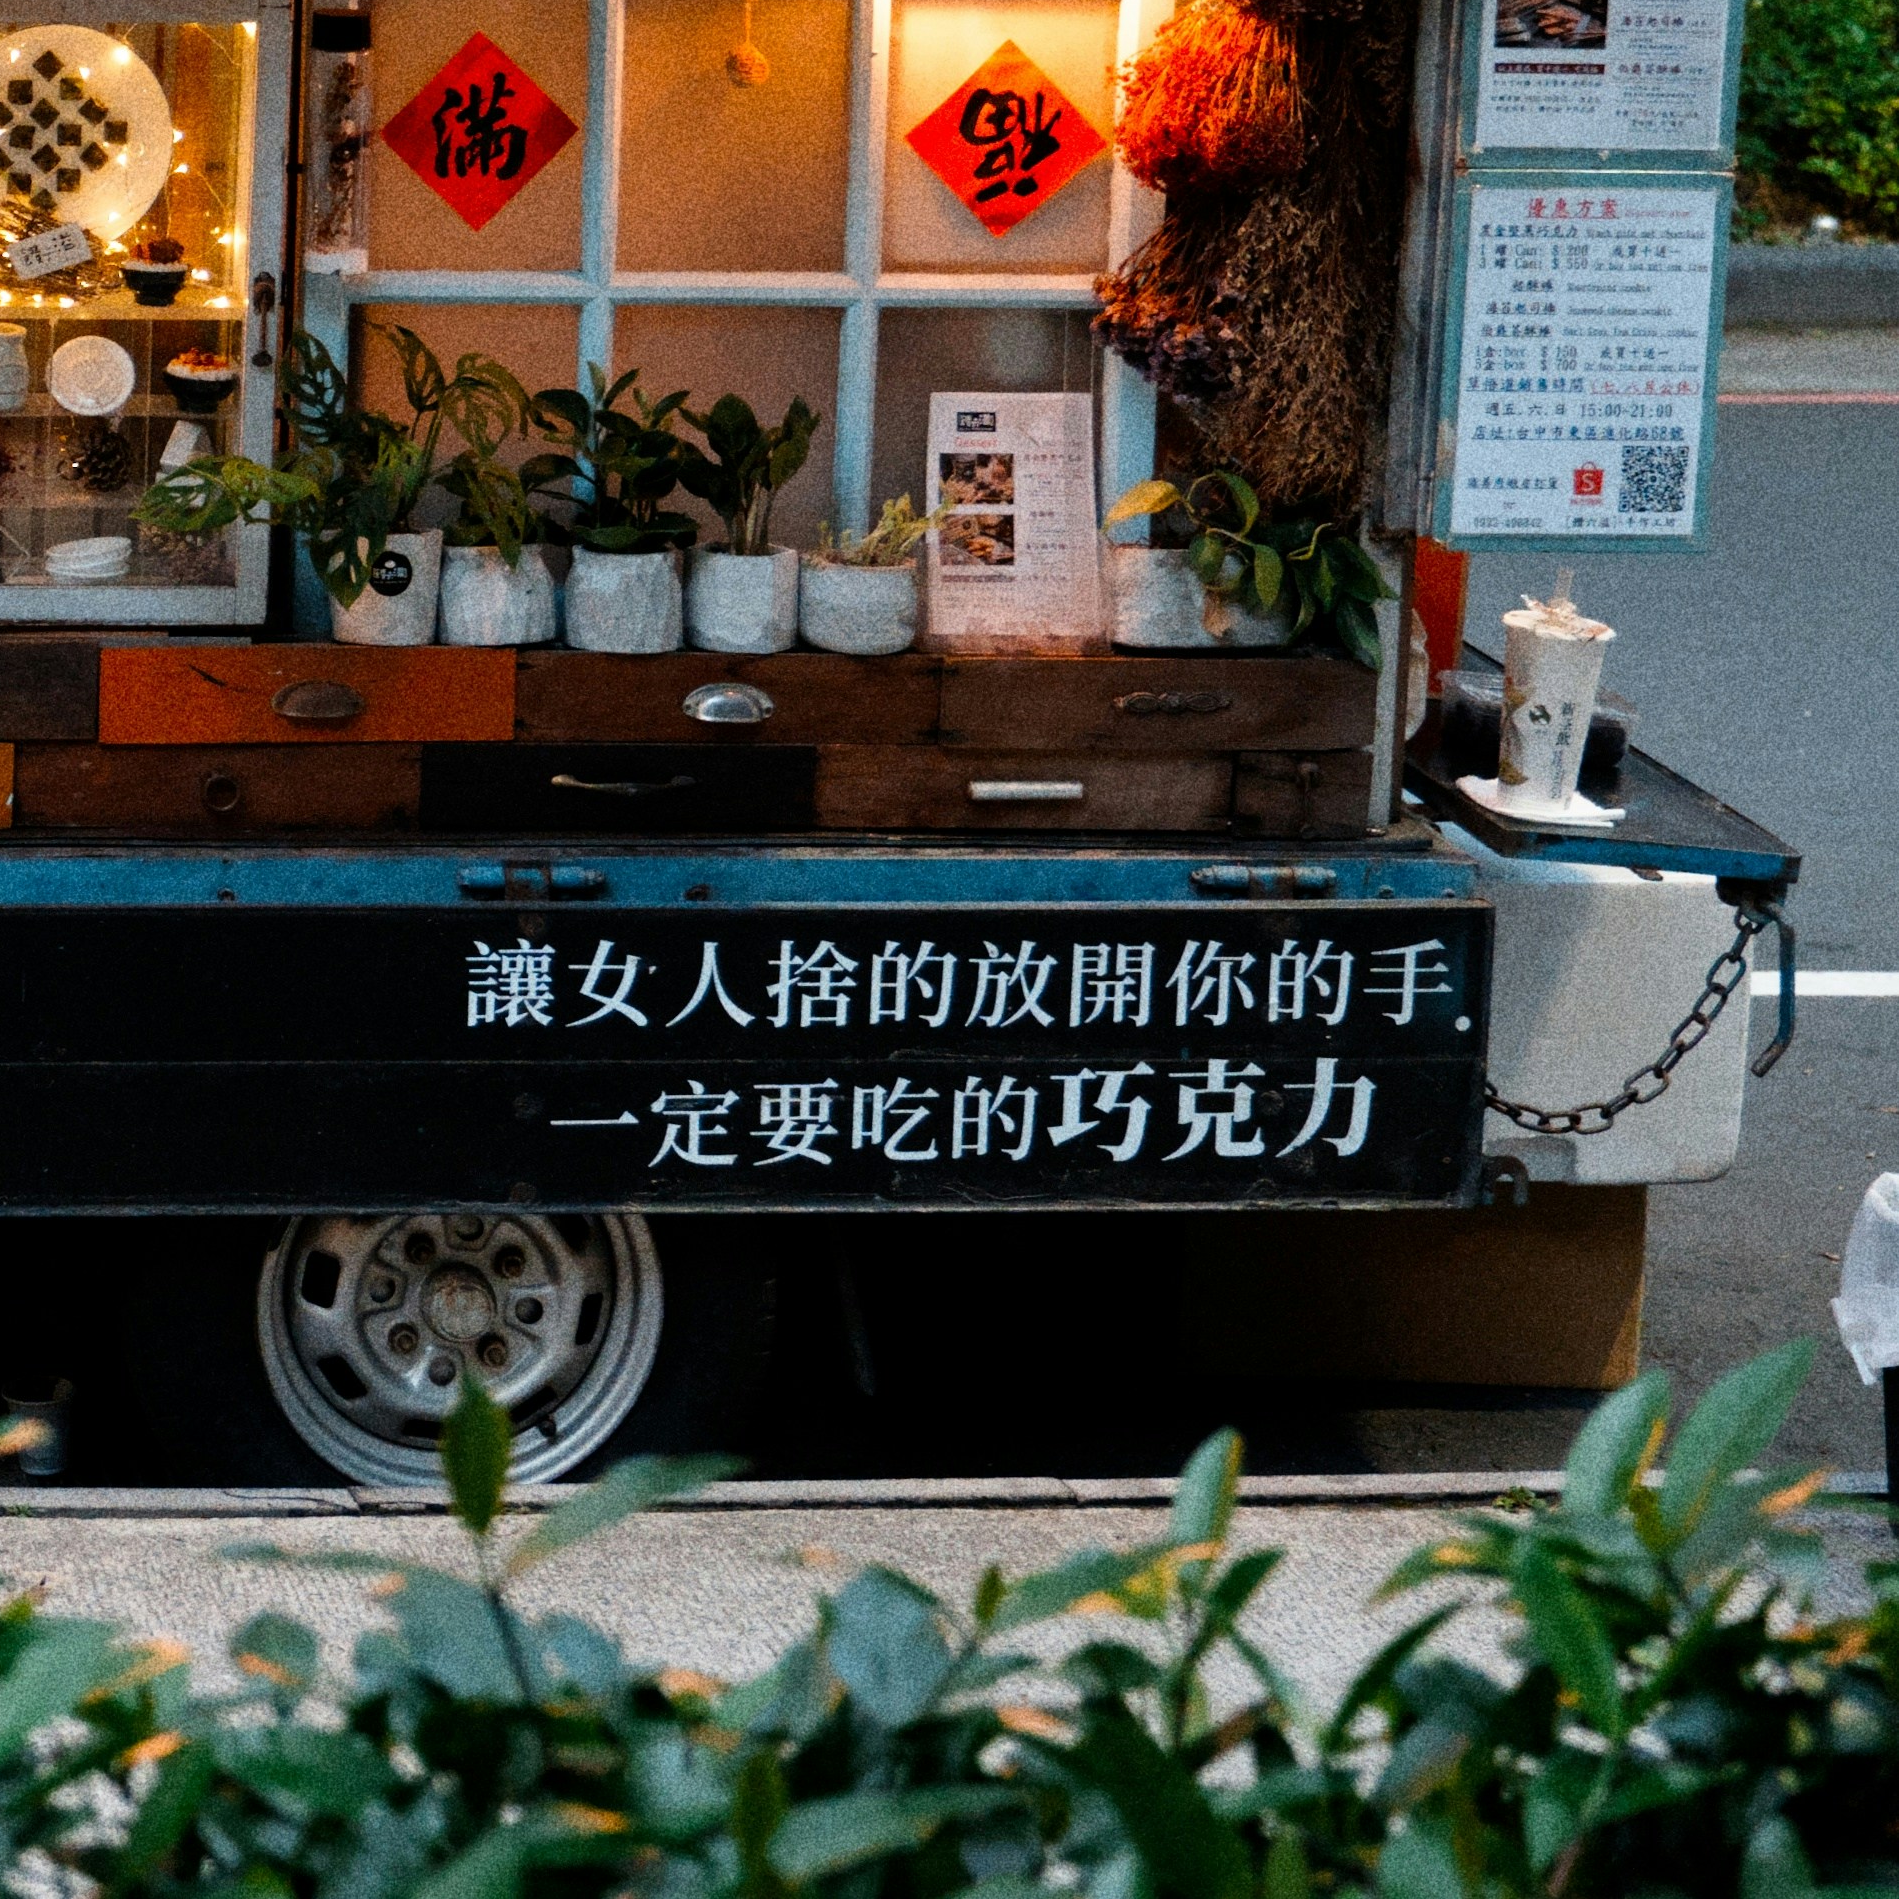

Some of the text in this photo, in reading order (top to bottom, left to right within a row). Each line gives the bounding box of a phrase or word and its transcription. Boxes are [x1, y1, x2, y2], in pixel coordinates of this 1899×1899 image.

[431, 72, 528, 183] 滿
[957, 87, 1061, 203] 福
[550, 1056, 1378, 1170] 一定要吃的巧克力
